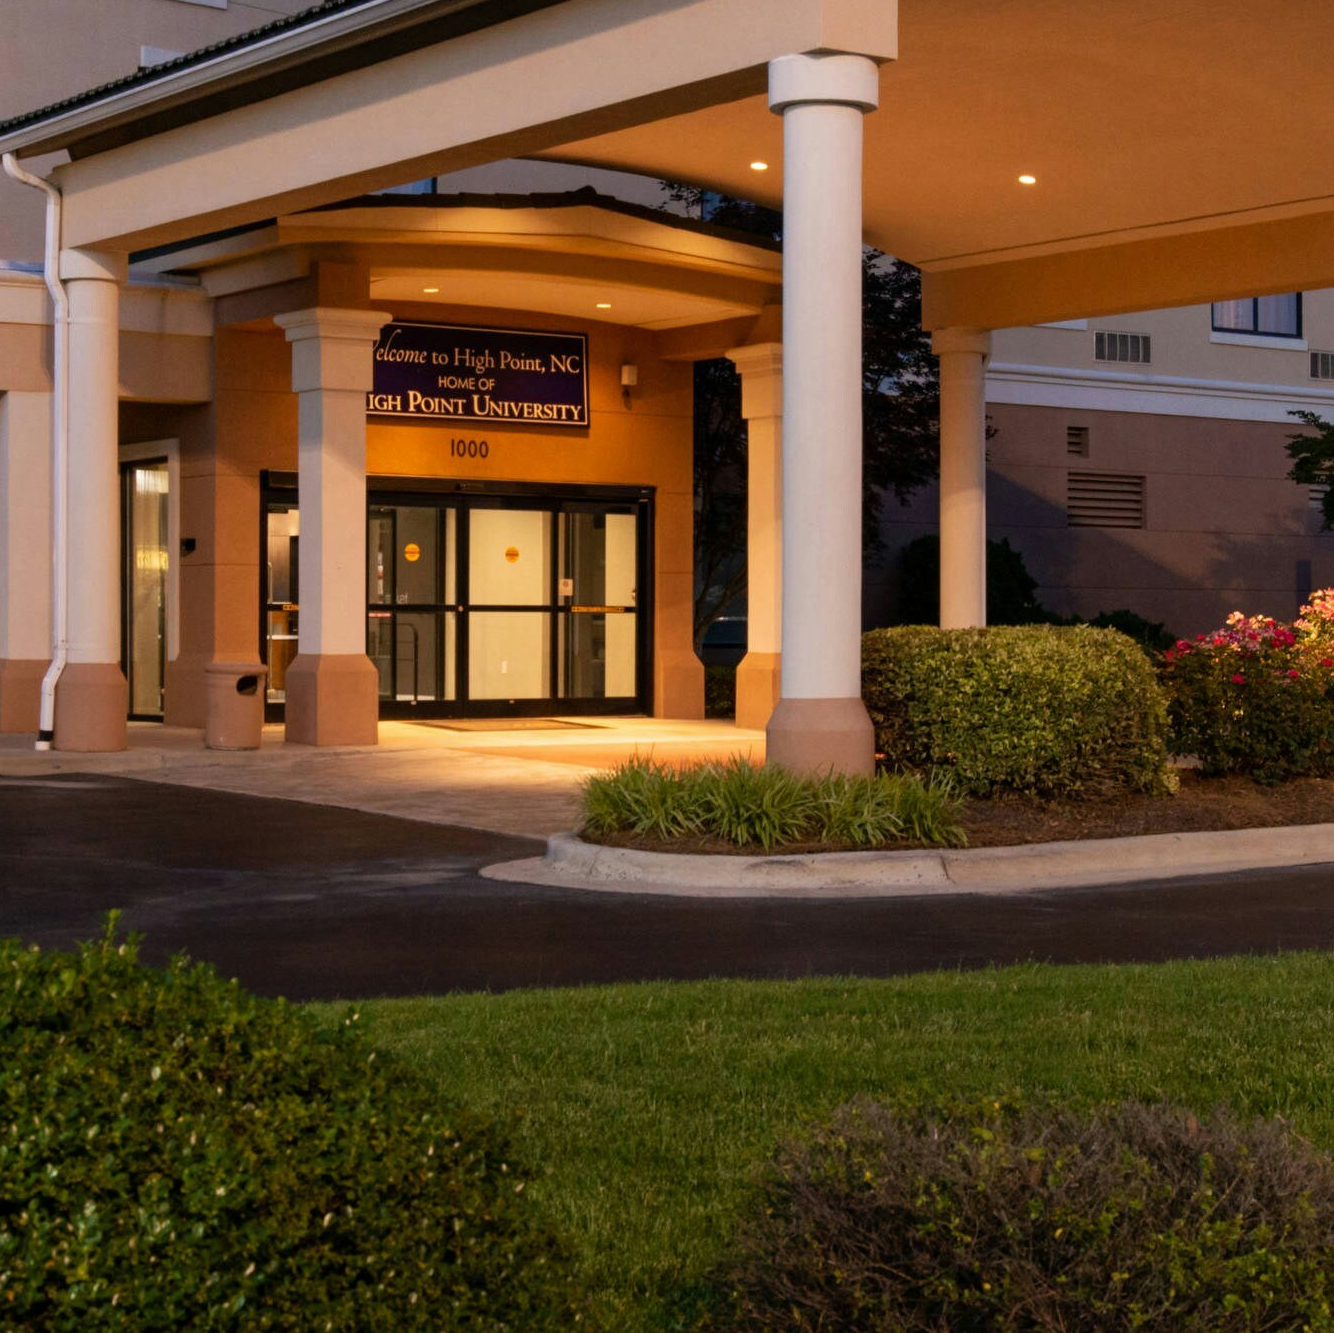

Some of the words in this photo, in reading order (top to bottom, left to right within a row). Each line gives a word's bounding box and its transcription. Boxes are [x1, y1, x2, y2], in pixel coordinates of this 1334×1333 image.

[373, 329, 427, 364] elcome
[432, 351, 449, 365] to
[454, 347, 495, 374] High
[499, 350, 546, 374] Point,
[550, 354, 580, 374] NC
[438, 375, 476, 390] HOME
[478, 378, 496, 391] OF
[367, 393, 402, 412] IGH
[407, 389, 467, 415] POINT
[472, 394, 582, 421] UNIVERSITY
[450, 438, 490, 459] 1000
